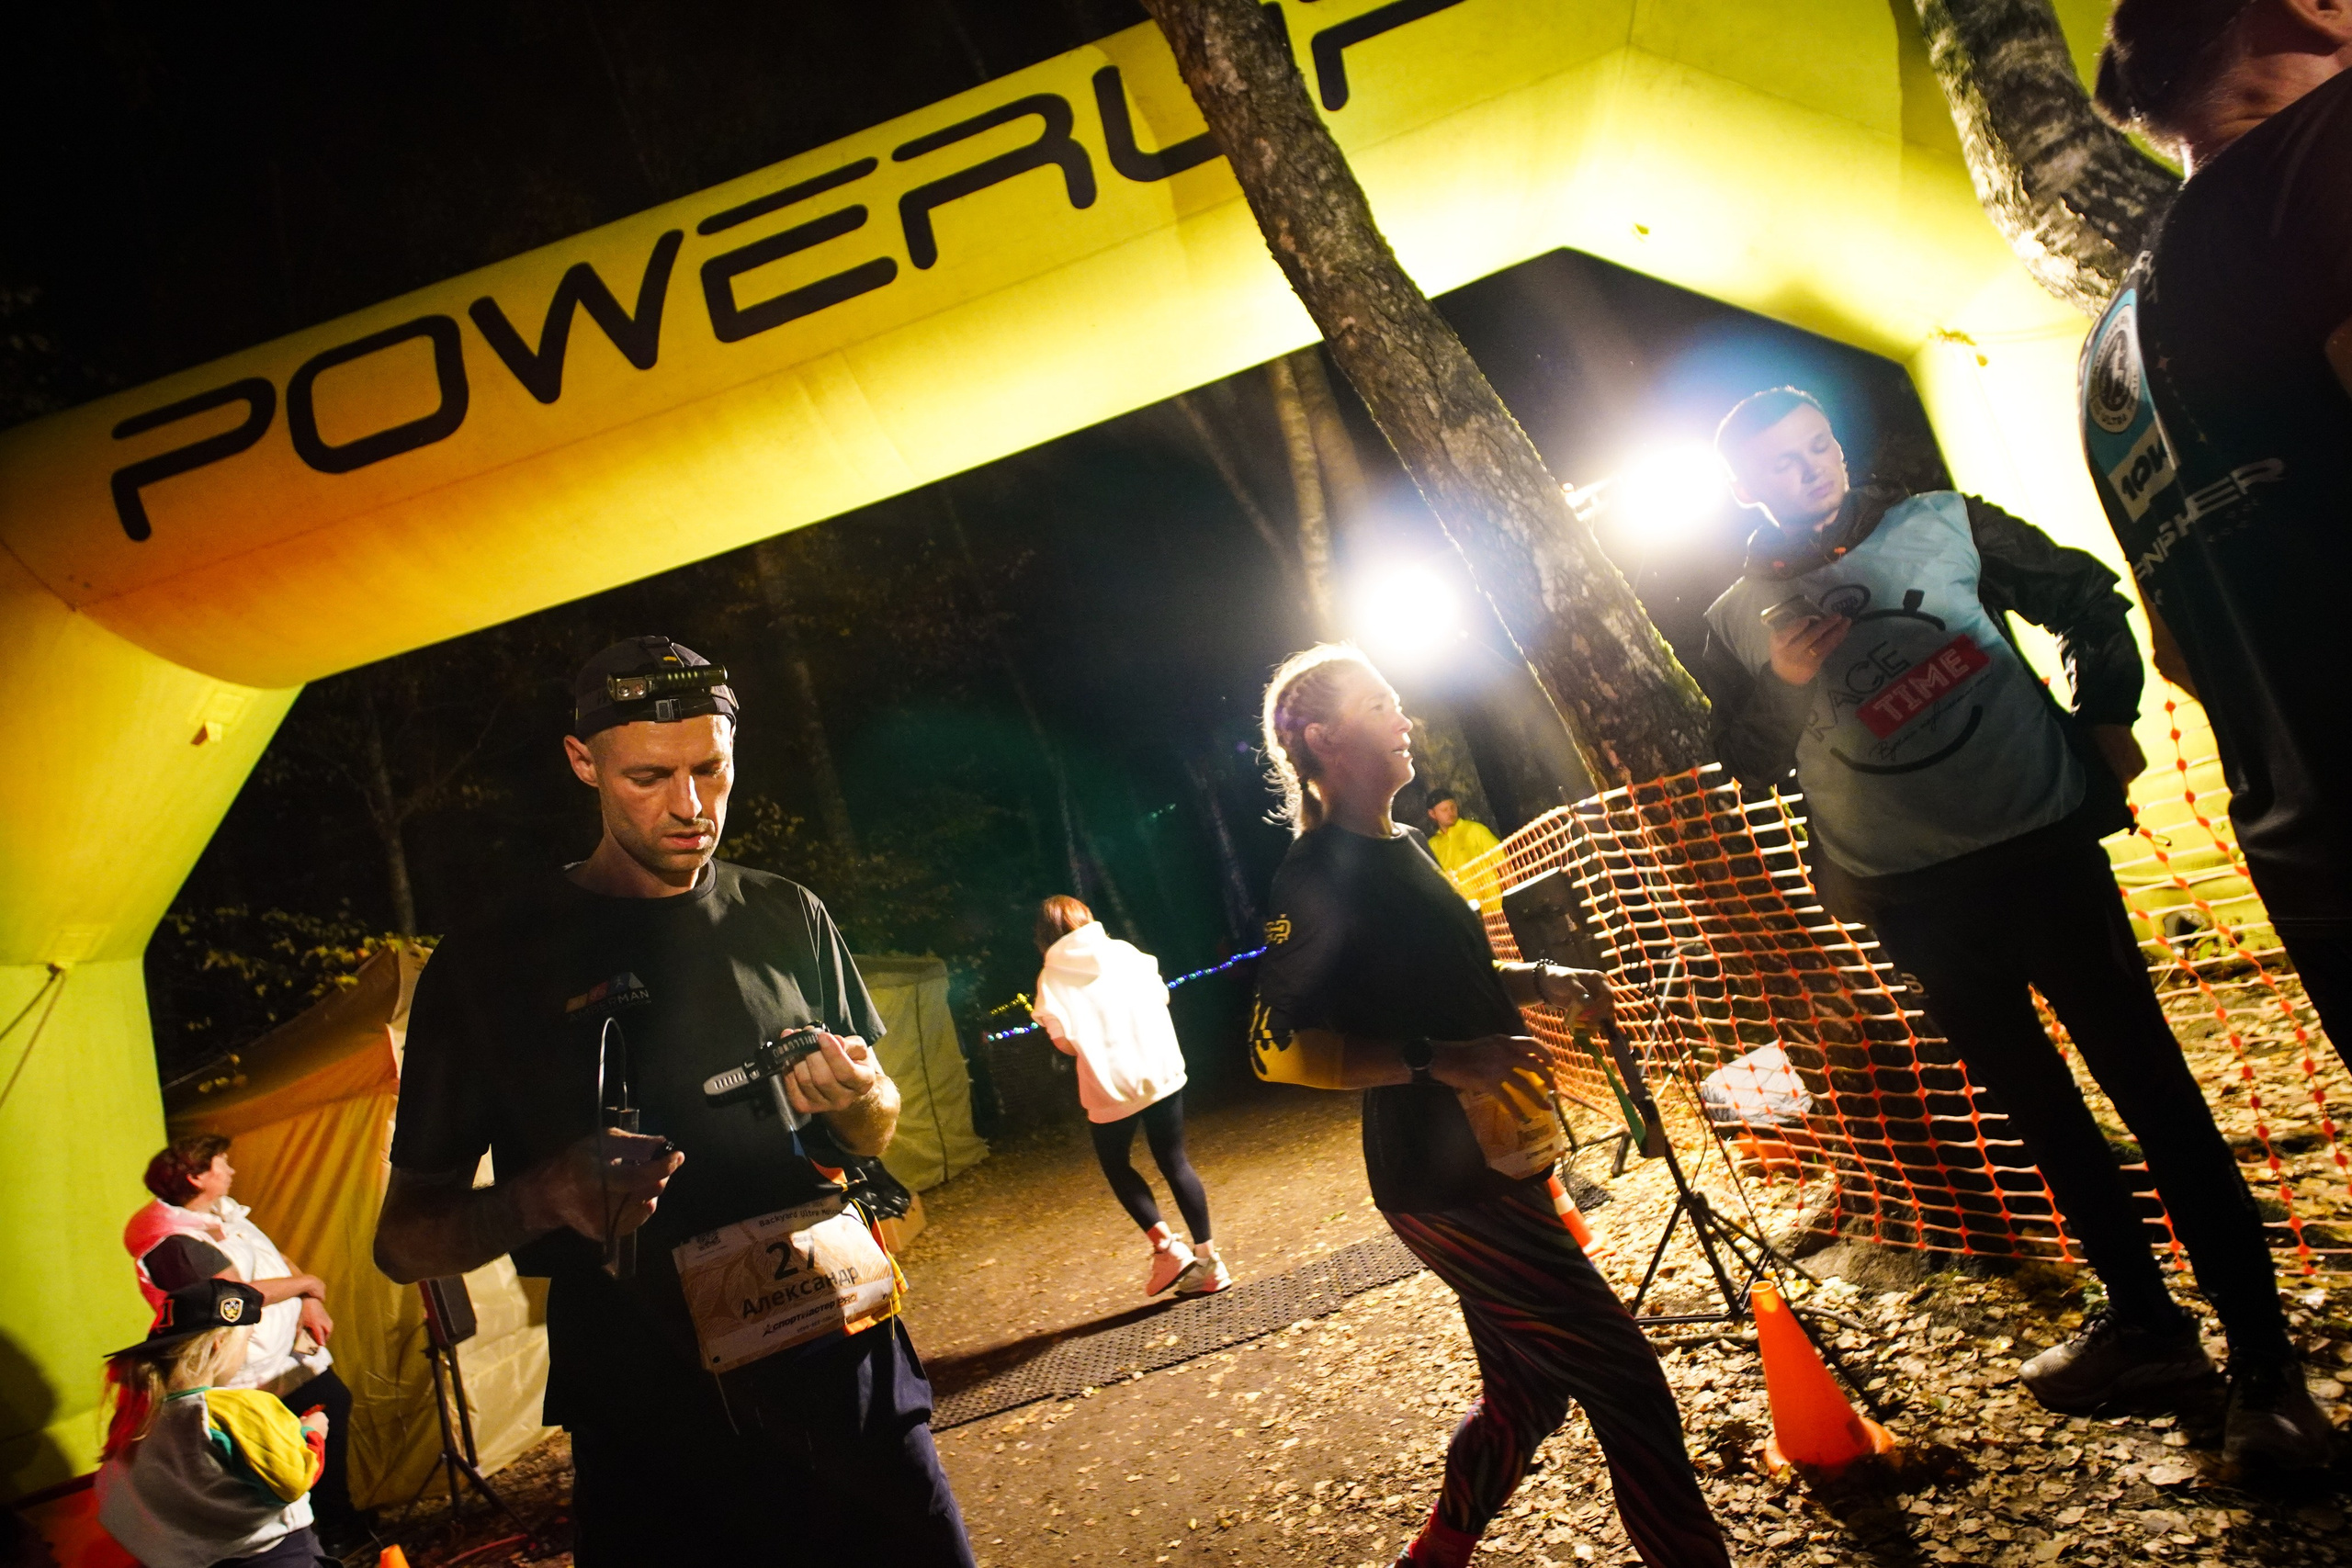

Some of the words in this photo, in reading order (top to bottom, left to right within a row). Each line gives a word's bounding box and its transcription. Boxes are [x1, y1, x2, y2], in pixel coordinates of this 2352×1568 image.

[1806, 641, 1911, 743] RACE
[1872, 649, 1970, 721] TIME
[759, 1213, 797, 1226] Backyard
[800, 1210, 820, 1218] Ultra
[765, 1234, 815, 1280] 27
[742, 1266, 859, 1319] Александр
[838, 1294, 857, 1305] PRO
